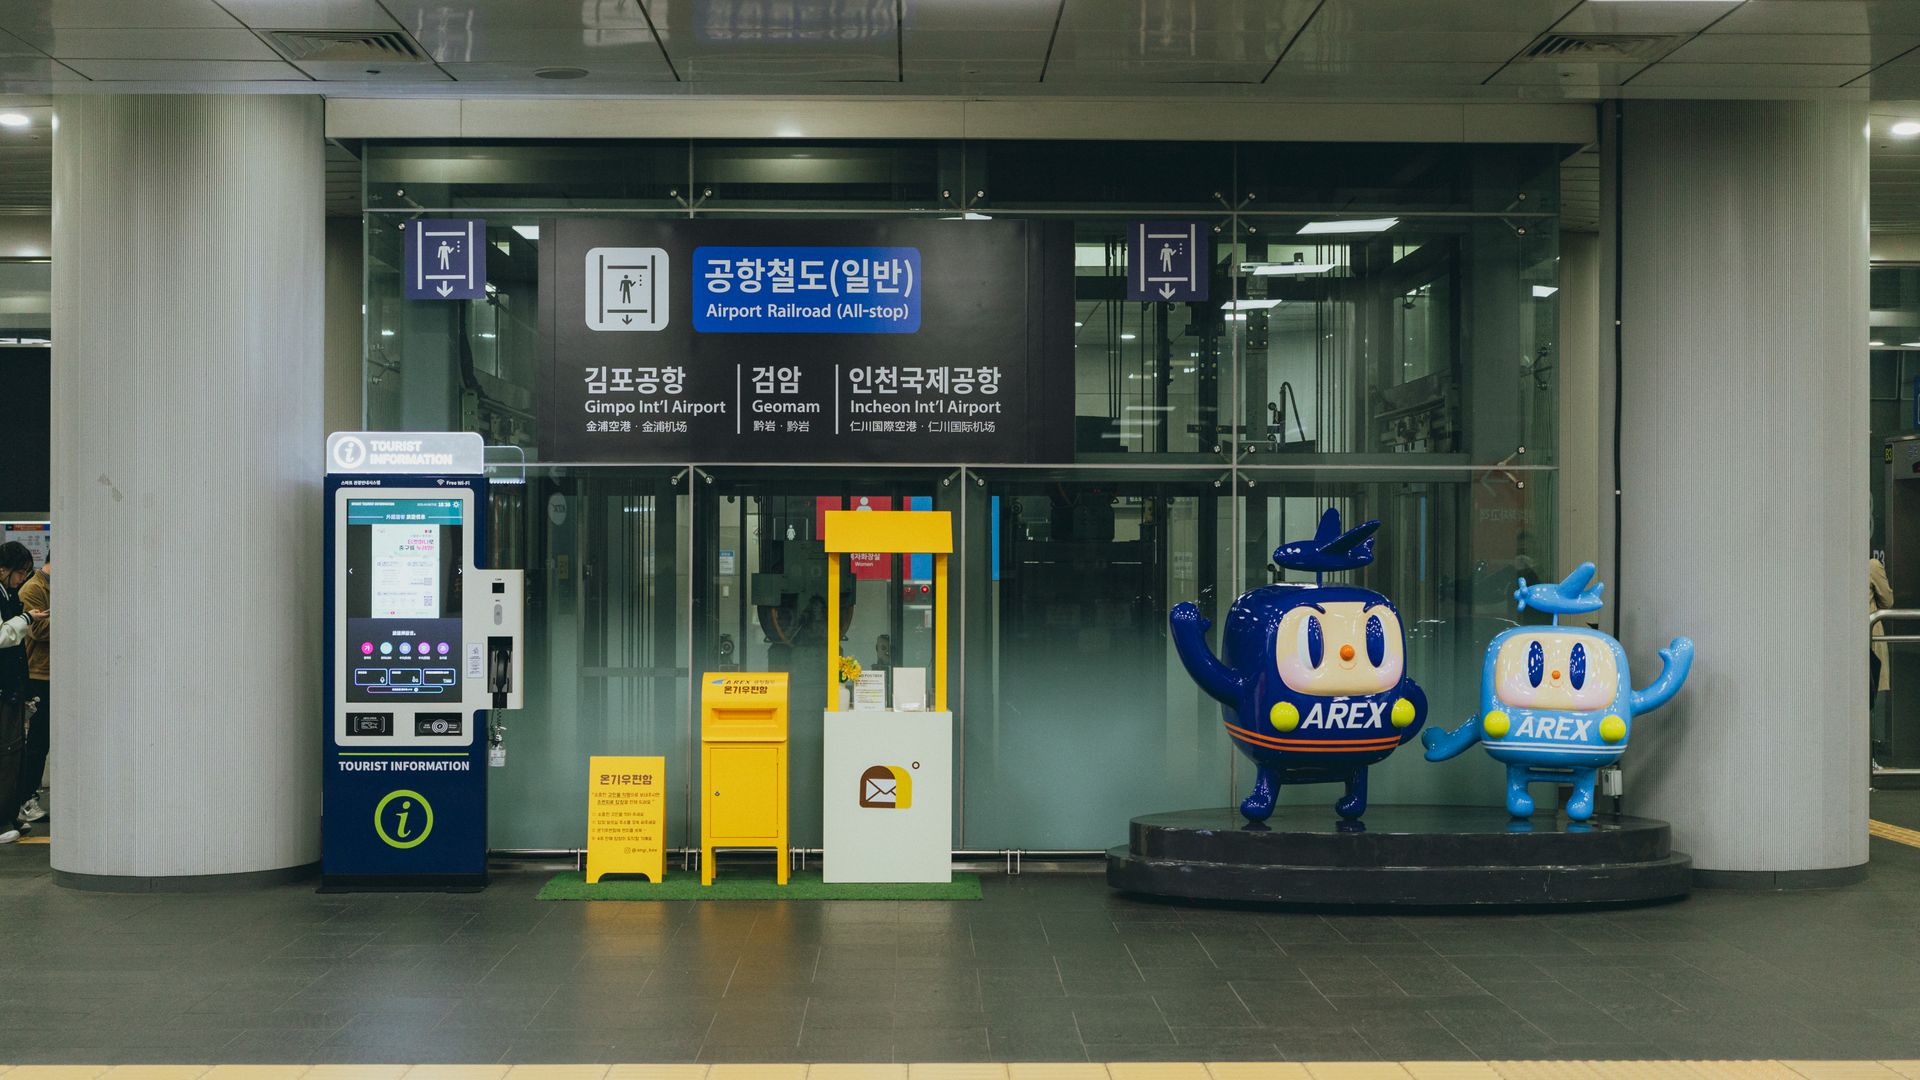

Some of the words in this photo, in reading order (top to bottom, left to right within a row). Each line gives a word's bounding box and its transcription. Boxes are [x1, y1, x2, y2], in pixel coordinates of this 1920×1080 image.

[705, 258, 913, 296] 공항철도(일반)
[706, 303, 762, 321] Airport
[767, 303, 831, 318] Railroad
[836, 303, 909, 321] (All-stop)
[584, 366, 686, 394] 김포공항
[751, 366, 802, 394] 검암
[849, 366, 1001, 394] 인천국제공항
[584, 400, 635, 416] Gimpo
[672, 400, 726, 416] Airport
[752, 400, 820, 413] Geomam
[850, 400, 910, 413] Incheon
[947, 400, 1001, 416] Airport
[370, 440, 422, 452] TOURIST
[370, 453, 453, 466] INFORMATION
[724, 685, 768, 695] 온기우편함
[1300, 702, 1388, 729] AREX
[1514, 716, 1593, 741] AREX
[338, 761, 389, 771] TOURIST
[390, 761, 470, 771] INFORMATION
[600, 774, 653, 786] 온기우편함
